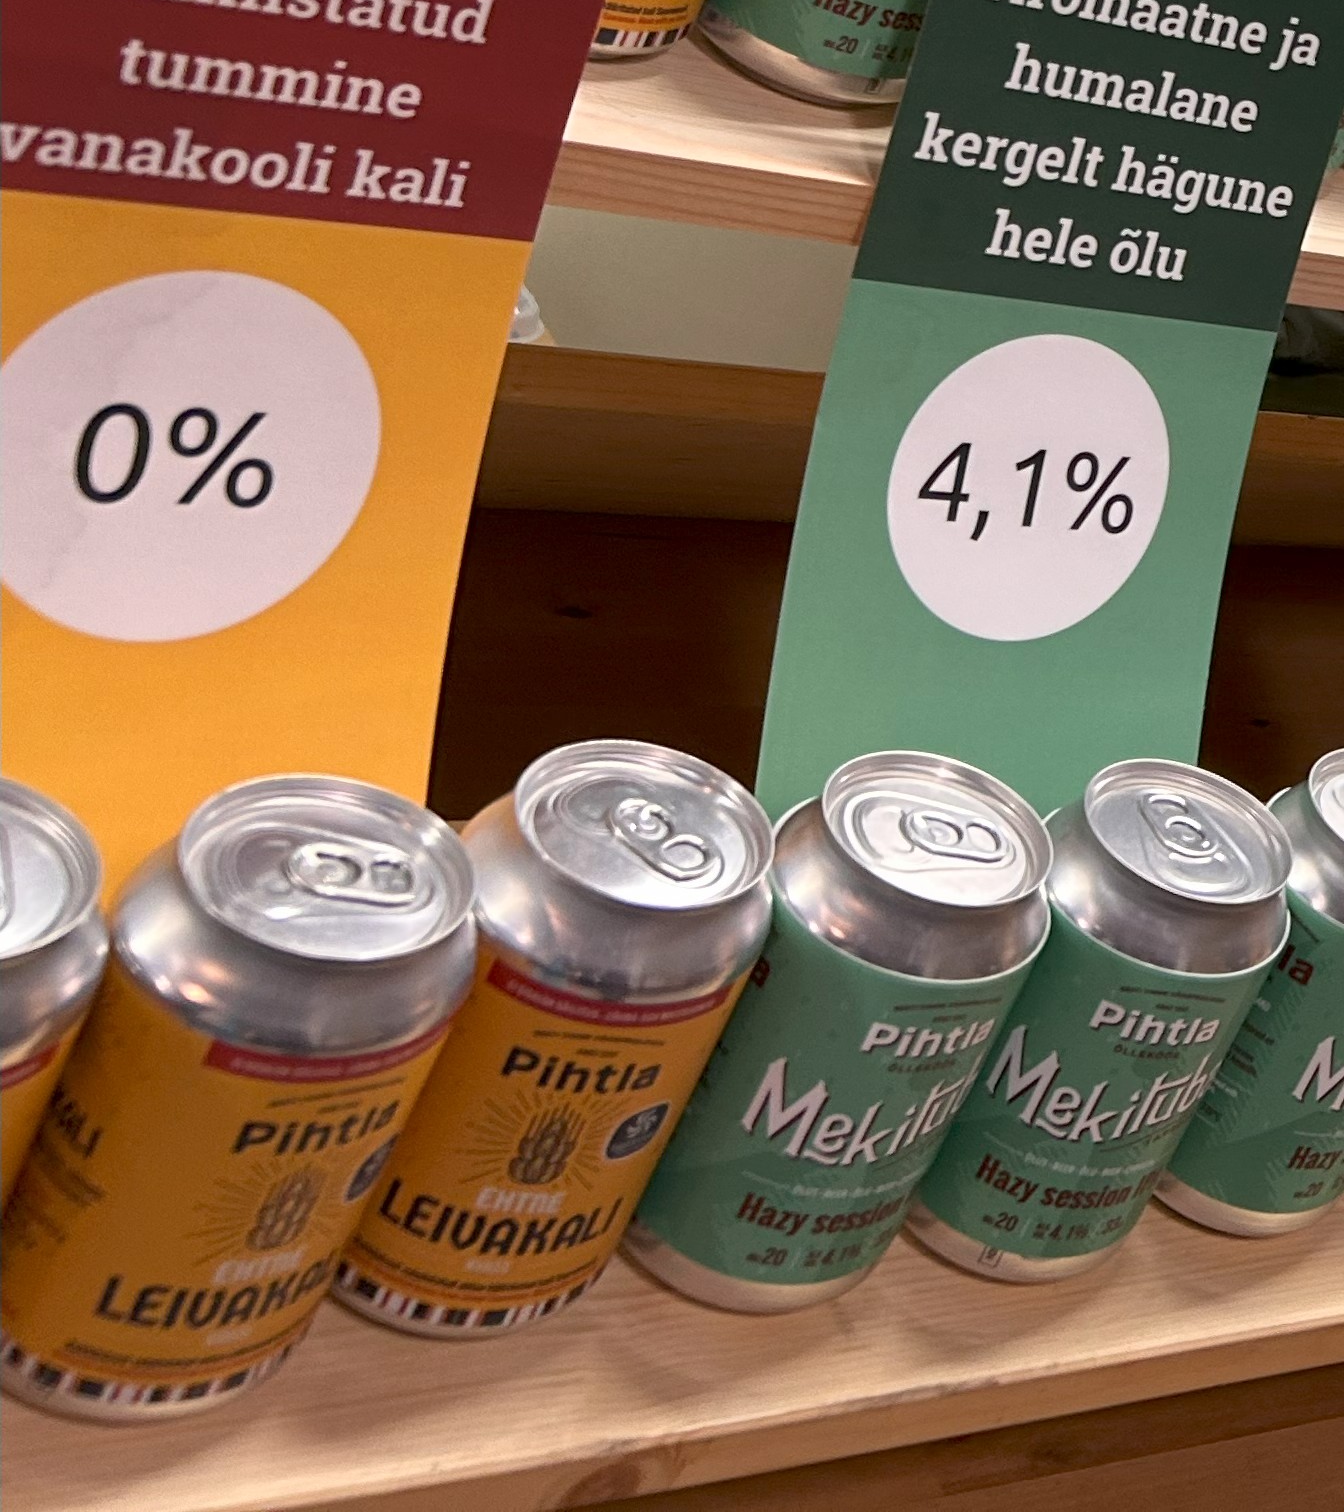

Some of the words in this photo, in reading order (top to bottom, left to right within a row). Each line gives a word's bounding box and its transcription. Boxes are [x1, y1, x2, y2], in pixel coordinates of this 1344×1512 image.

[118, 39, 422, 121] tummine
[1268, 17, 1322, 71] ja
[1003, 42, 1259, 133] humalane
[0, 120, 337, 194] vanakooli
[345, 149, 471, 208] kali
[912, 111, 1104, 188] kergelt
[1110, 145, 1295, 218] hägune
[984, 207, 1098, 269] hele
[1108, 227, 1188, 282] õlu
[73, 402, 276, 509] 0%
[917, 441, 1134, 542] 4,1%
[859, 1018, 996, 1059] Pihtla
[1089, 999, 1222, 1047] Pihtla
[499, 1045, 663, 1096] Pihtla
[230, 1098, 403, 1158] Pihtla
[378, 1177, 625, 1257] LEIVAKALI
[736, 1191, 812, 1238] Hazy
[974, 1152, 1040, 1204] Hazy
[1038, 1176, 1133, 1211] session
